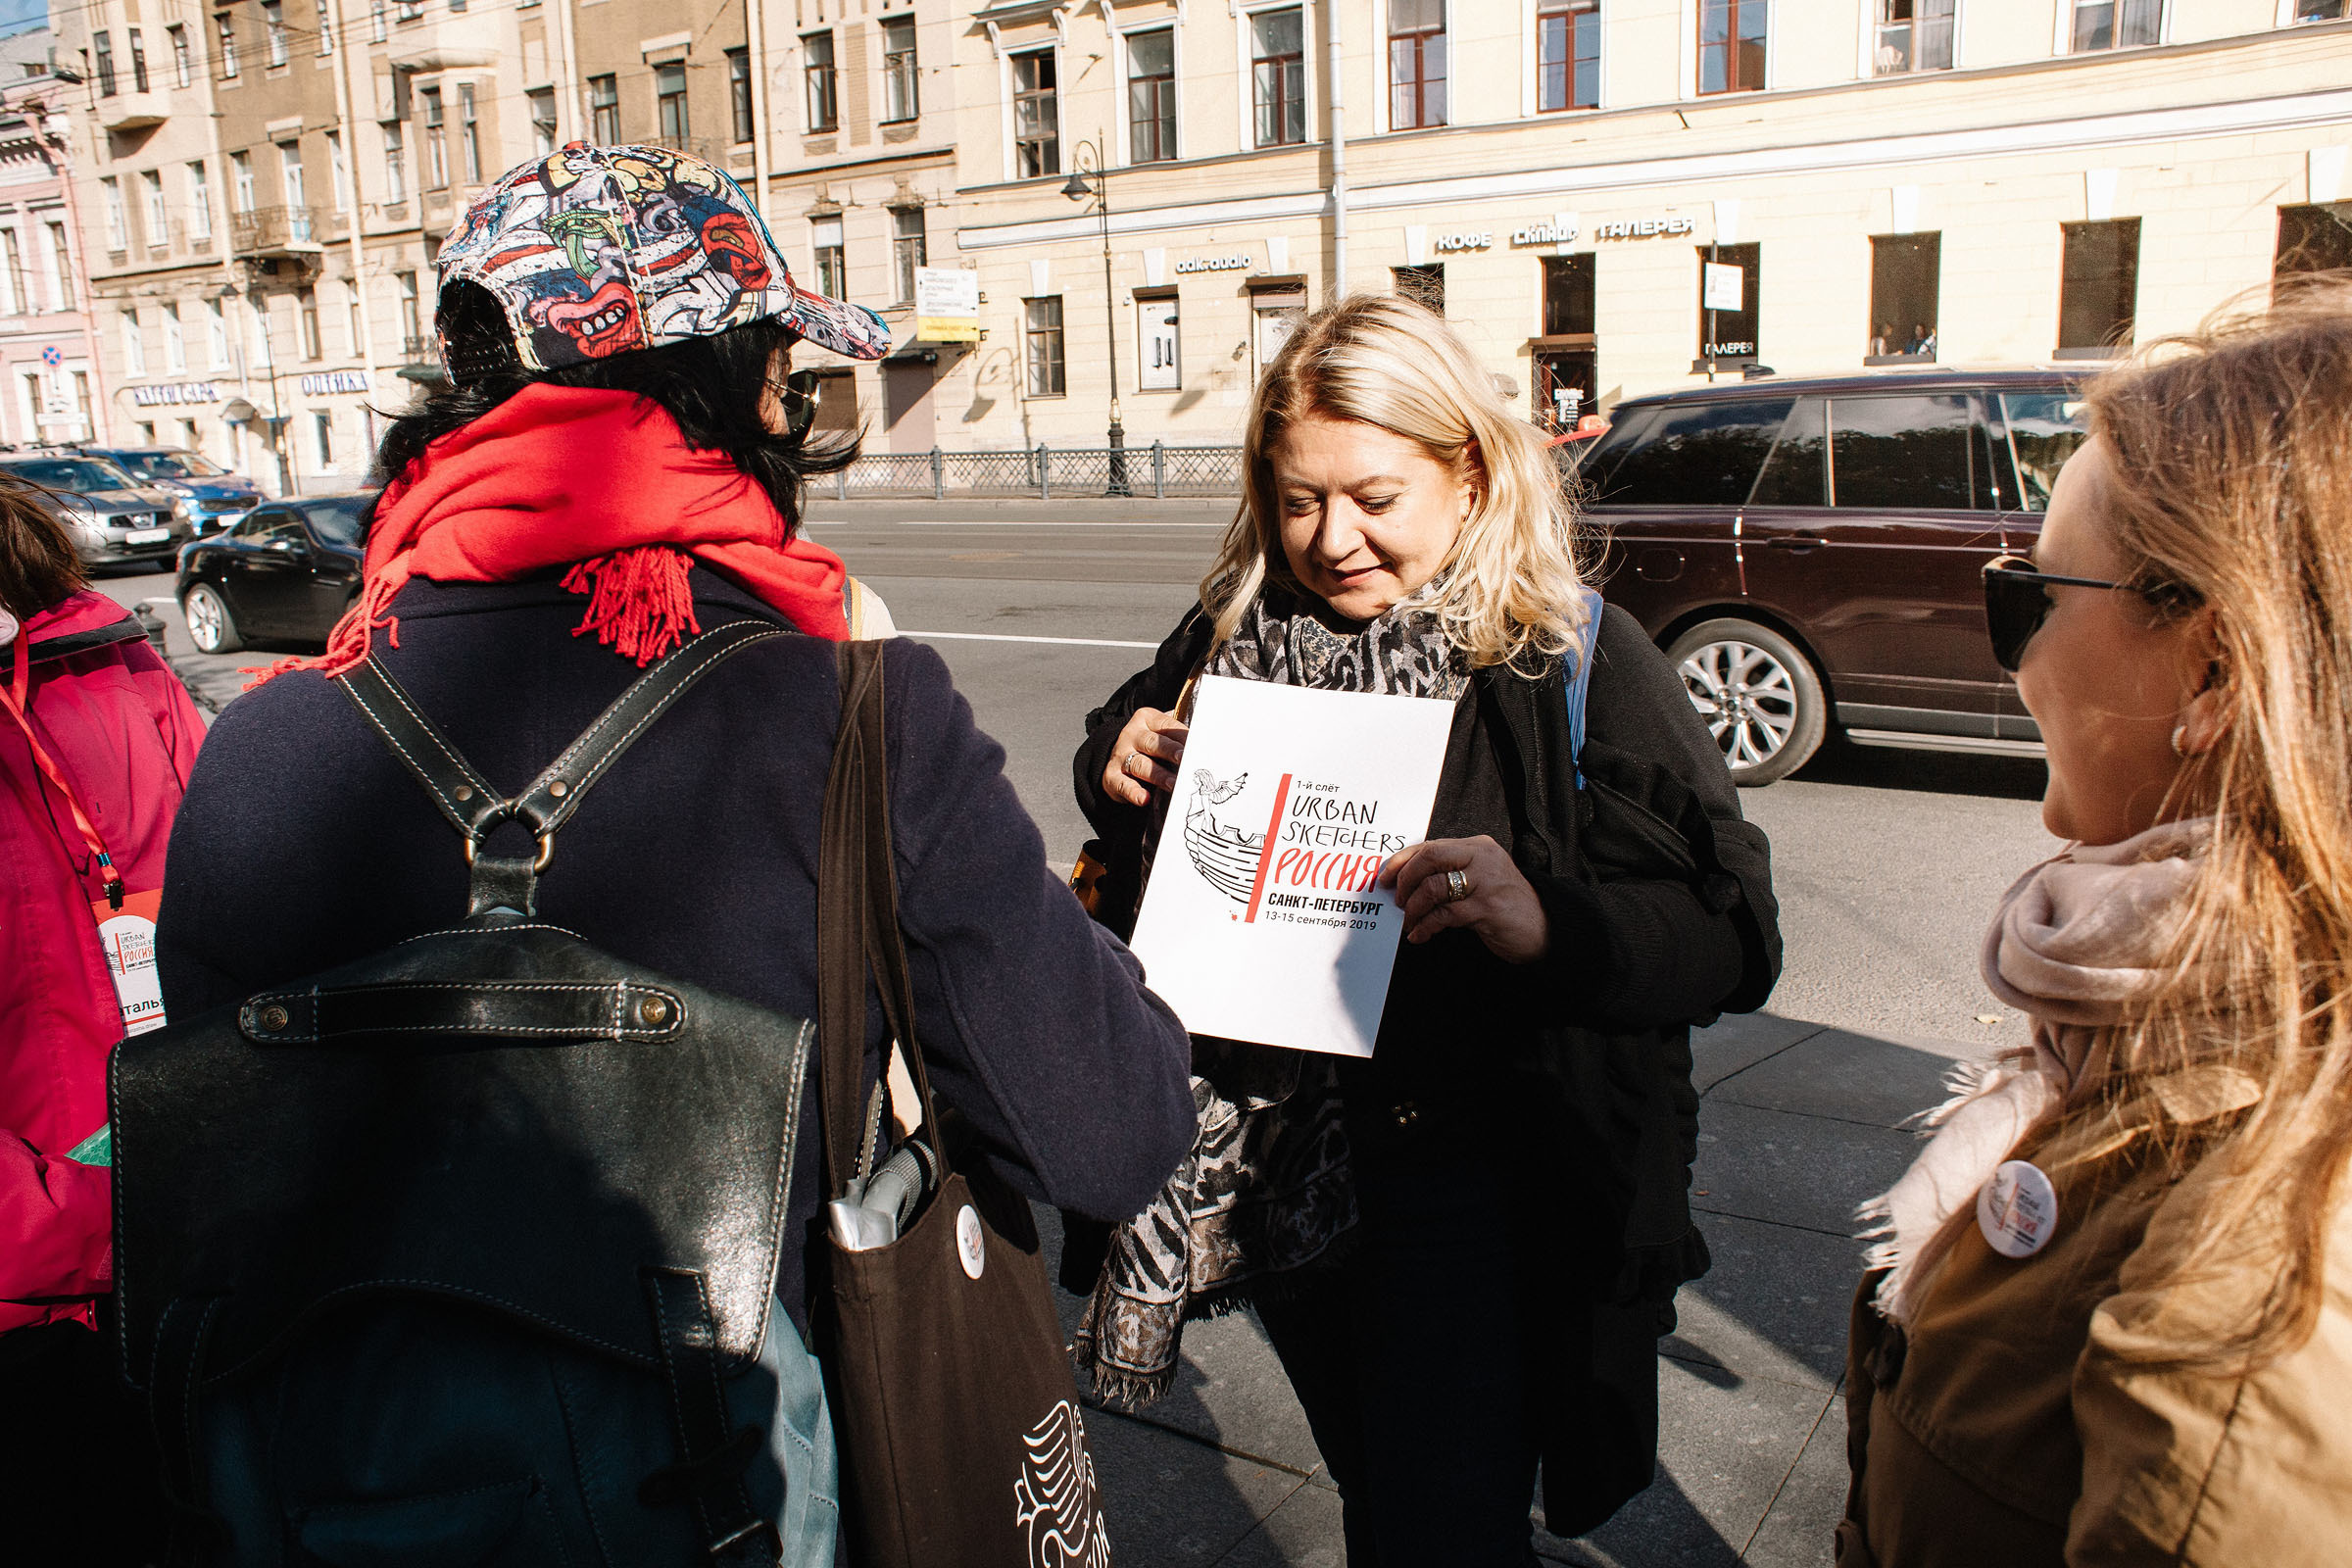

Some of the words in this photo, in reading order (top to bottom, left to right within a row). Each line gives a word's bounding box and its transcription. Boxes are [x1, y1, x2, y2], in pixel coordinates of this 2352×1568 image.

[1439, 232, 1493, 251] КОФЕ
[1599, 217, 1696, 239] ГАЛЕРЕЯ
[1705, 341, 1754, 355] ГАЛЕРЕЯ
[301, 371, 368, 397] ОПТИКА
[1297, 780, 1313, 791] 1-й
[1315, 783, 1341, 793] слёт
[1292, 794, 1379, 824] URBAN
[1281, 820, 1406, 855] SKETCHERS
[1274, 847, 1384, 894] РОССИЯ
[1268, 892, 1385, 916] САНКТ-ПЕТЕРБУРГ
[1264, 909, 1296, 923] 13-15
[1297, 915, 1348, 929] сентября
[1348, 918, 1378, 931] 2019
[122, 946, 154, 963] РОССИЯ
